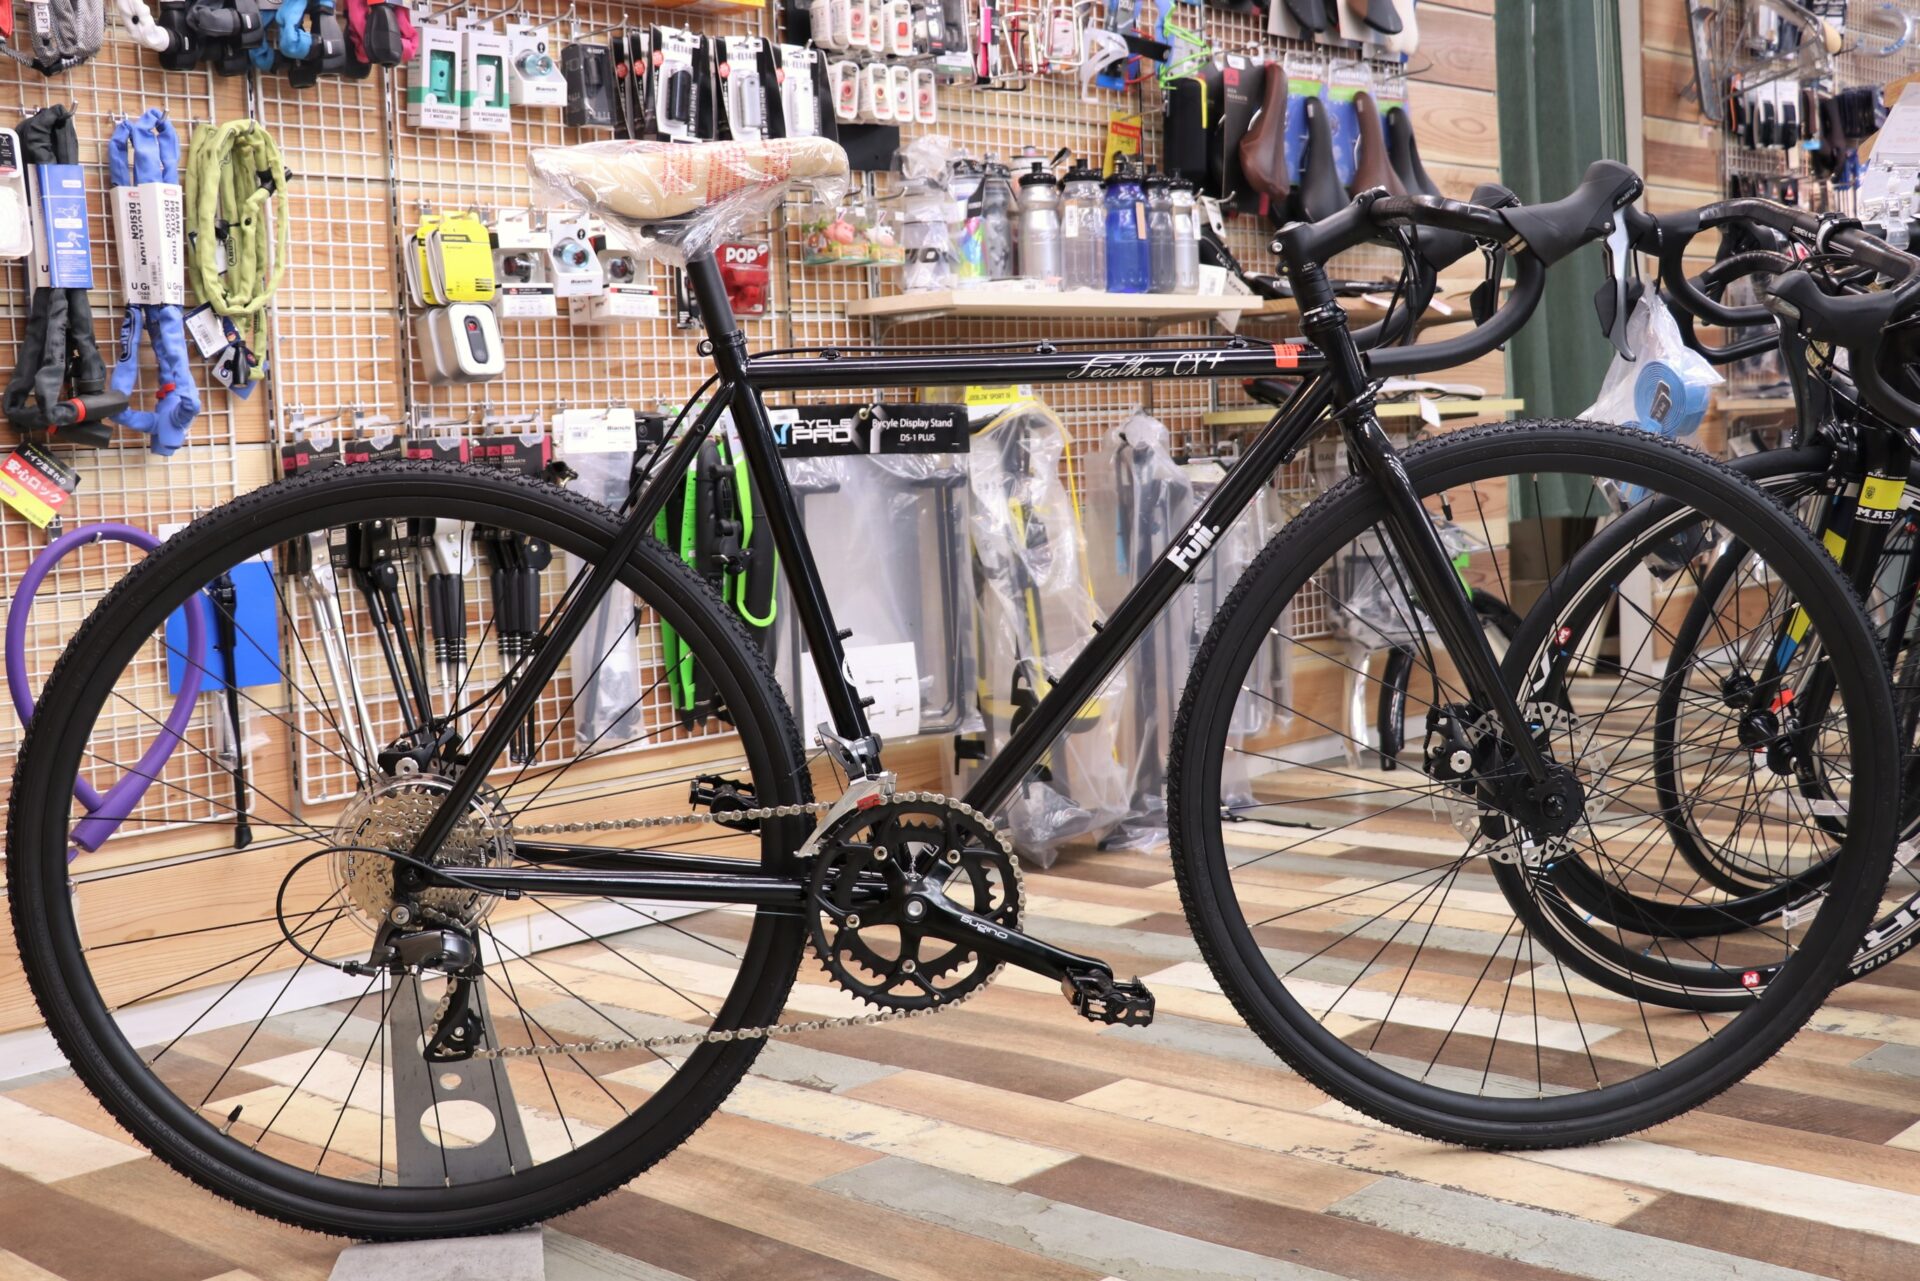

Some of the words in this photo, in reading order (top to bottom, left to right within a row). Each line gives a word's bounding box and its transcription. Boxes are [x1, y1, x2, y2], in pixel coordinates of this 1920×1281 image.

[128, 201, 139, 240] DESIGN
[726, 246, 758, 263] POP
[1066, 354, 1168, 380] Feather
[791, 418, 852, 430] CYCLE
[899, 417, 929, 431] Display
[930, 417, 953, 429] Stand
[791, 429, 852, 446] PRO
[899, 433, 917, 443] DS-1
[919, 433, 936, 442] PLUS
[5, 458, 63, 504] 安心ロック
[1852, 937, 1912, 976] KENDA
